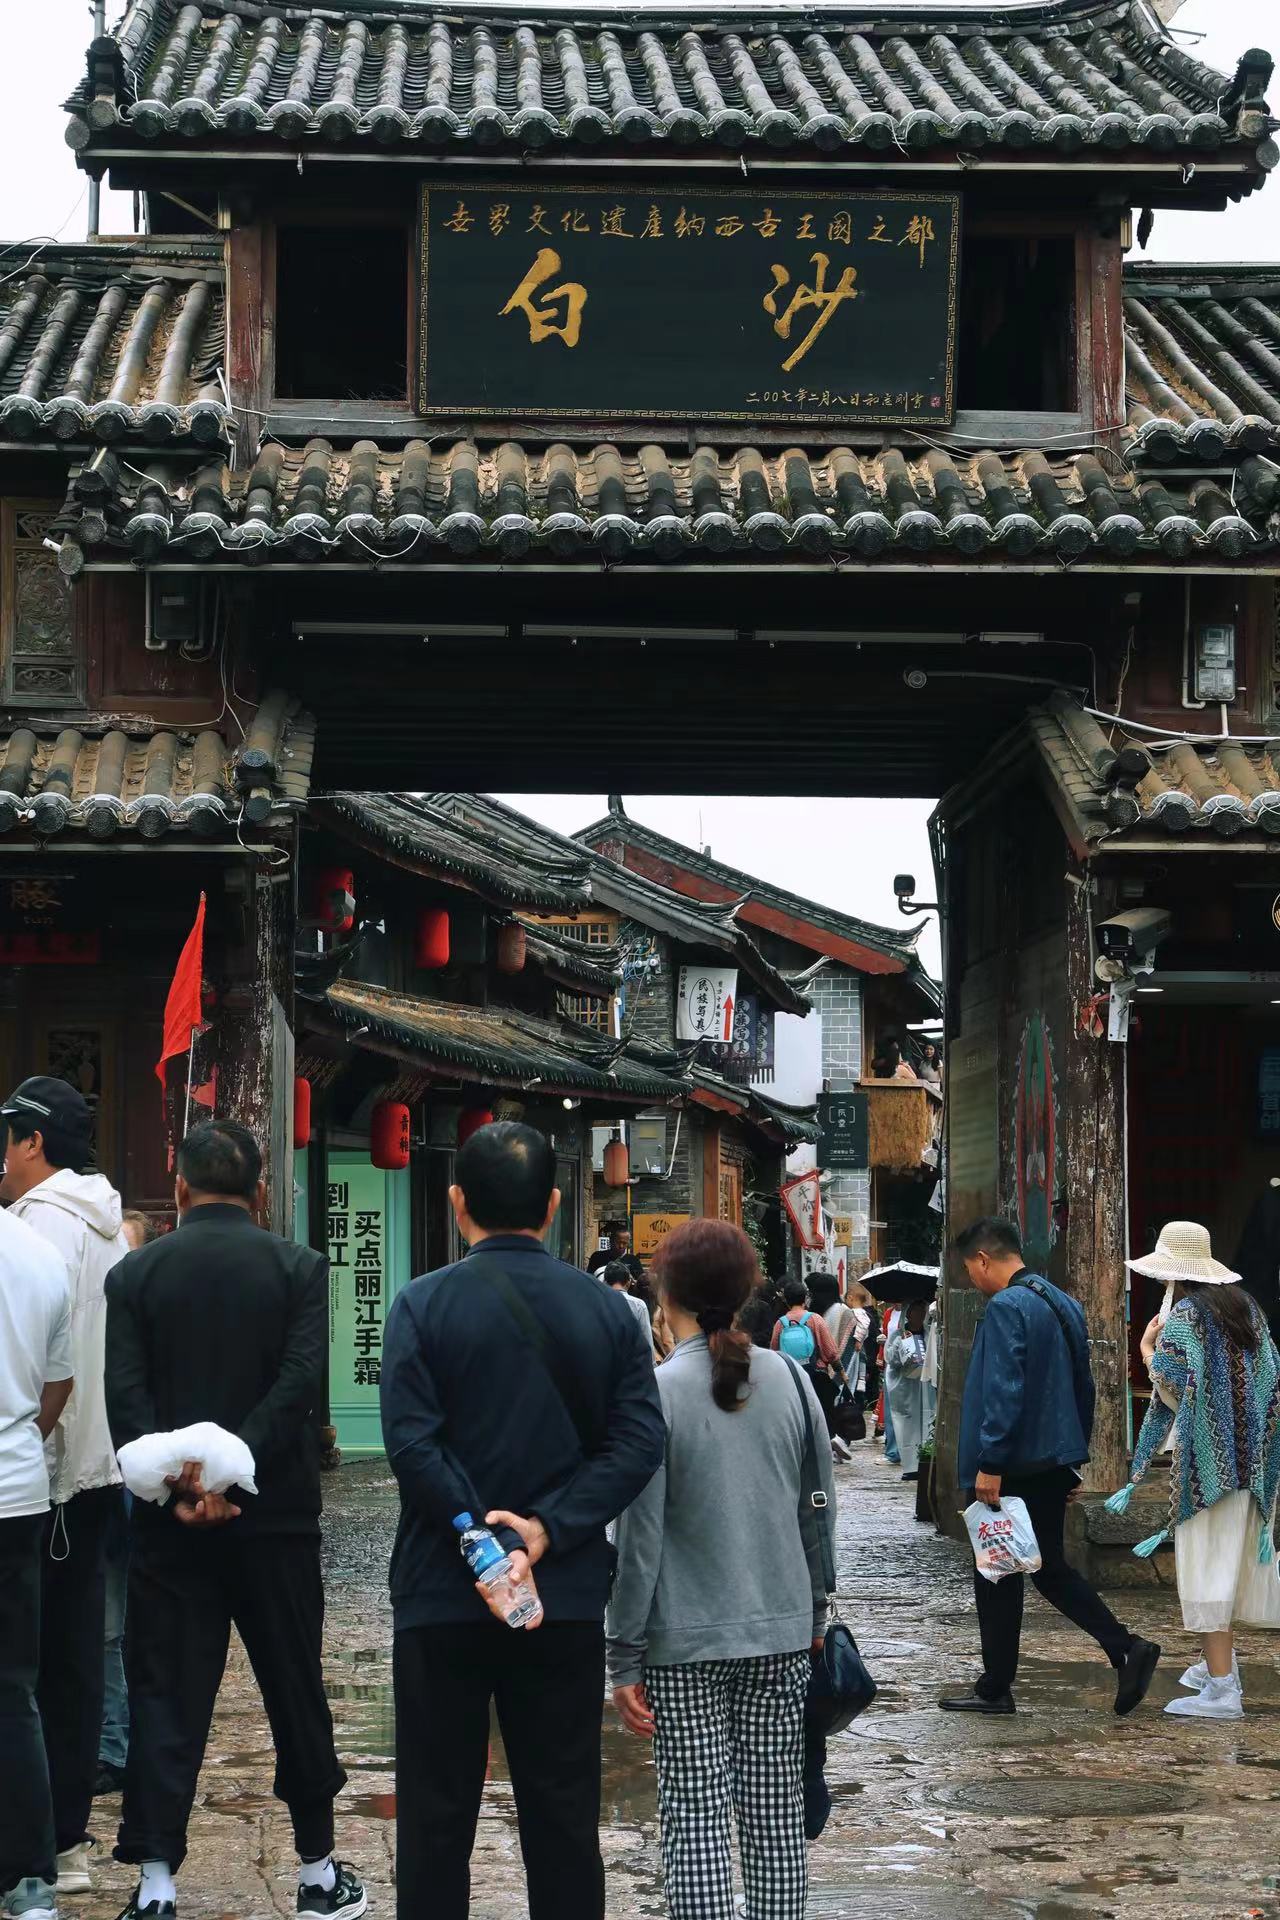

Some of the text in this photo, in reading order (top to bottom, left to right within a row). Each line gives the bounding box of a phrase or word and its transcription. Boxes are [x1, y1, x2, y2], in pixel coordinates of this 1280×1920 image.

[498, 247, 867, 371] 白沙
[354, 1211, 382, 1385] 买点丽江手霜
